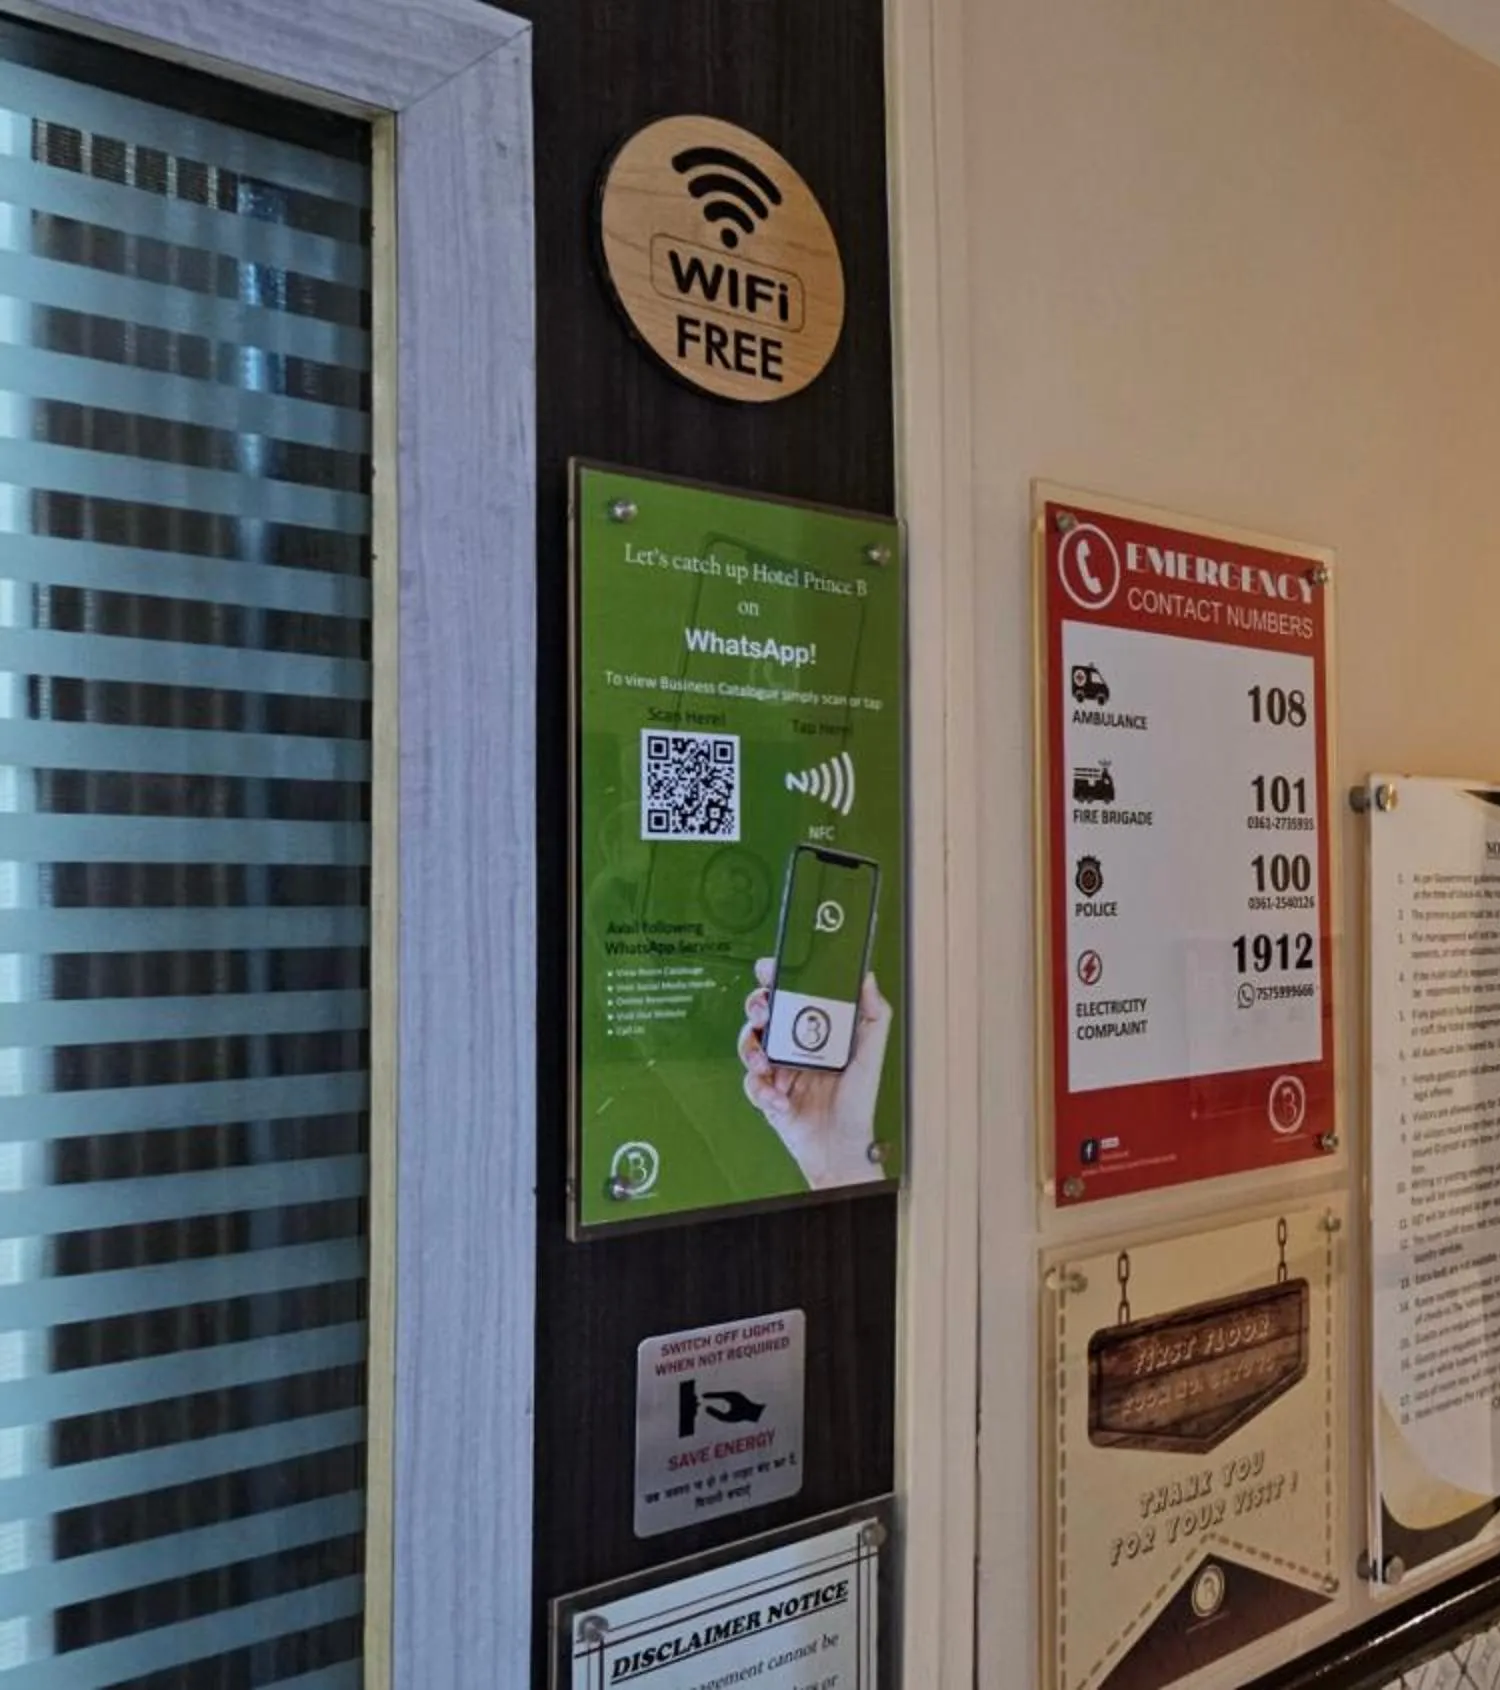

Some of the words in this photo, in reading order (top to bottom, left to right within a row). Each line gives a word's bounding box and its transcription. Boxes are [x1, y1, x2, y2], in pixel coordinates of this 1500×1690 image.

[676, 315, 784, 382] FREE
[624, 543, 668, 568] Let's
[673, 553, 722, 578] catch
[726, 564, 748, 584] up
[753, 563, 800, 589] Hotel
[803, 573, 854, 597] Prince
[856, 580, 868, 597] B
[1126, 541, 1314, 605] EMERGENCY
[737, 599, 760, 617] on
[1127, 586, 1223, 625] CONTACT
[1226, 608, 1314, 640] NUMBERS
[685, 626, 817, 667] WhatsApp!
[605, 670, 622, 687] To
[660, 676, 716, 695] Business
[1072, 709, 1149, 731] AMBULANCE
[1248, 685, 1307, 728] 108
[1073, 808, 1099, 825] FIRE
[1101, 809, 1153, 827] BRIGADE
[1251, 775, 1307, 815] 101
[808, 825, 835, 841] NFC
[1075, 901, 1118, 918] POLICE
[1251, 853, 1311, 893] 100
[1232, 932, 1314, 974] 1912
[1075, 998, 1148, 1019] ELECTRICITY
[1076, 1019, 1149, 1041] COMPLAINT
[654, 1357, 696, 1378] WHEN
[699, 1350, 723, 1368] NOT
[727, 1336, 791, 1361] REQUIRED
[661, 1334, 711, 1357] SWITCH
[715, 1329, 739, 1346] OFF
[742, 1319, 785, 1339] LIGHTS
[1134, 1335, 1197, 1376] FIRST
[1203, 1313, 1272, 1354] FLOOR
[666, 1446, 712, 1472] SAVE
[714, 1429, 776, 1460] ENERGY
[1139, 1470, 1213, 1519] THANK
[1222, 1449, 1265, 1488] YOU
[1109, 1525, 1156, 1568] FOR
[1166, 1501, 1226, 1544] YOUR
[610, 1610, 763, 1679] DISCLAIMER
[766, 1579, 849, 1624] NOTICE
[767, 1640, 819, 1671] cannot
[821, 1632, 840, 1650] be
